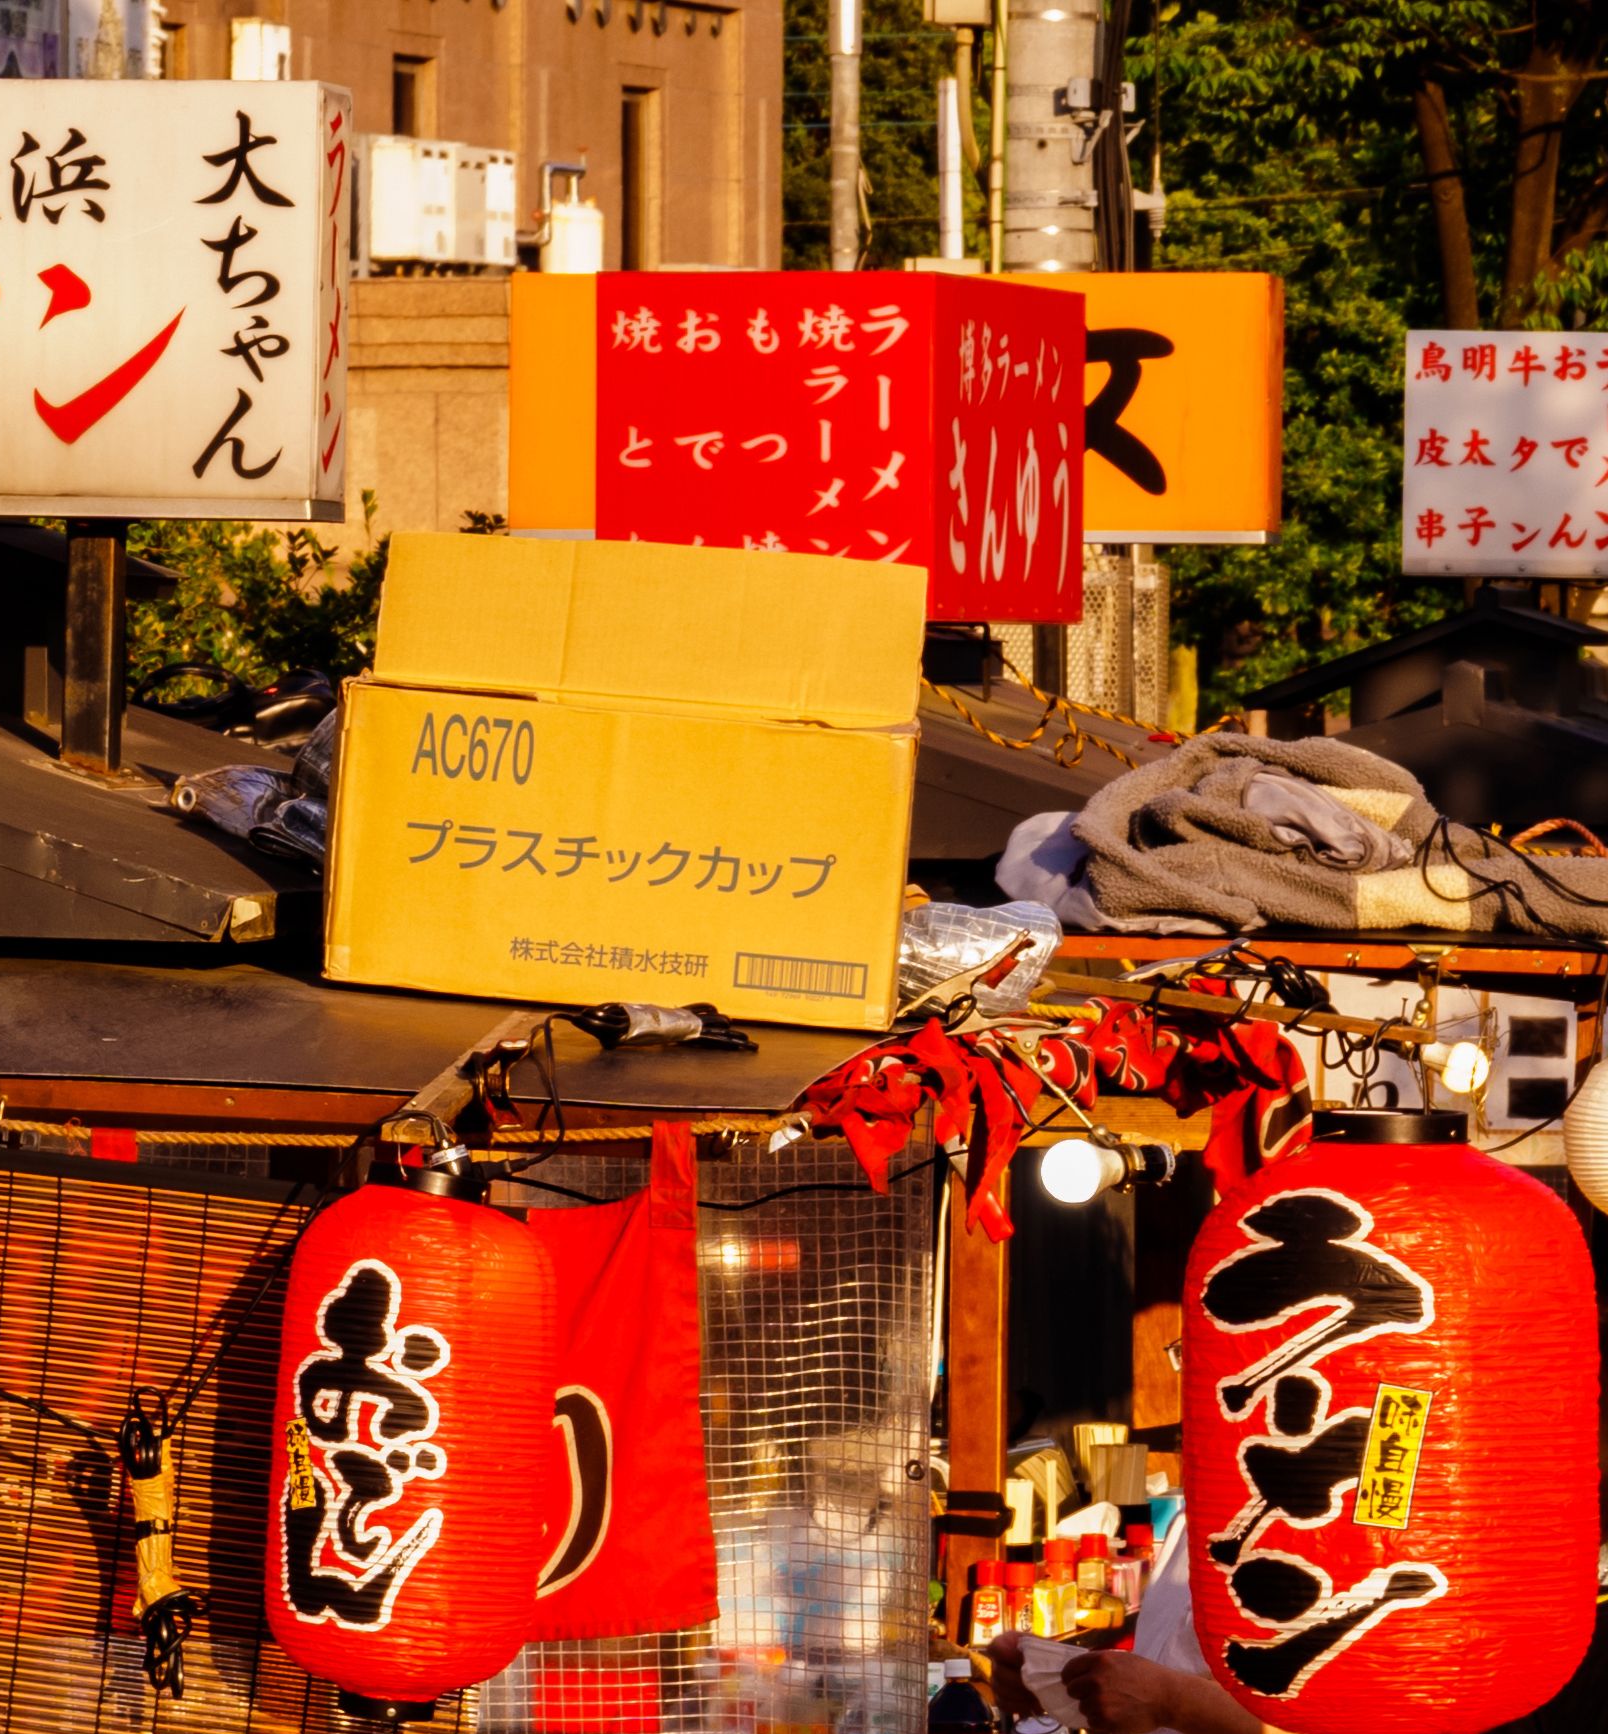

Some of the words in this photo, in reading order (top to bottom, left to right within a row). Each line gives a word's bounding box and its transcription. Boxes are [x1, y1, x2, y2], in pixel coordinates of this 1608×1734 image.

[191, 110, 296, 480] 大ちゃん
[322, 111, 345, 473] ラーメン
[958, 318, 1064, 406] 博多ラーメン
[611, 306, 662, 542] 焼と
[673, 309, 724, 546] おで
[860, 304, 912, 562] ラーメン
[948, 415, 1069, 595] さんゆう
[1414, 342, 1452, 549] 鳥皮串
[1458, 343, 1497, 546] 明太子
[1508, 348, 1547, 553] 牛タン
[1550, 344, 1589, 550] おでん
[412, 712, 535, 785] AC670
[405, 818, 838, 899] プラスチックカップ
[509, 936, 710, 980] 株式会社積水技研
[1200, 1188, 1448, 1702] ラーメン
